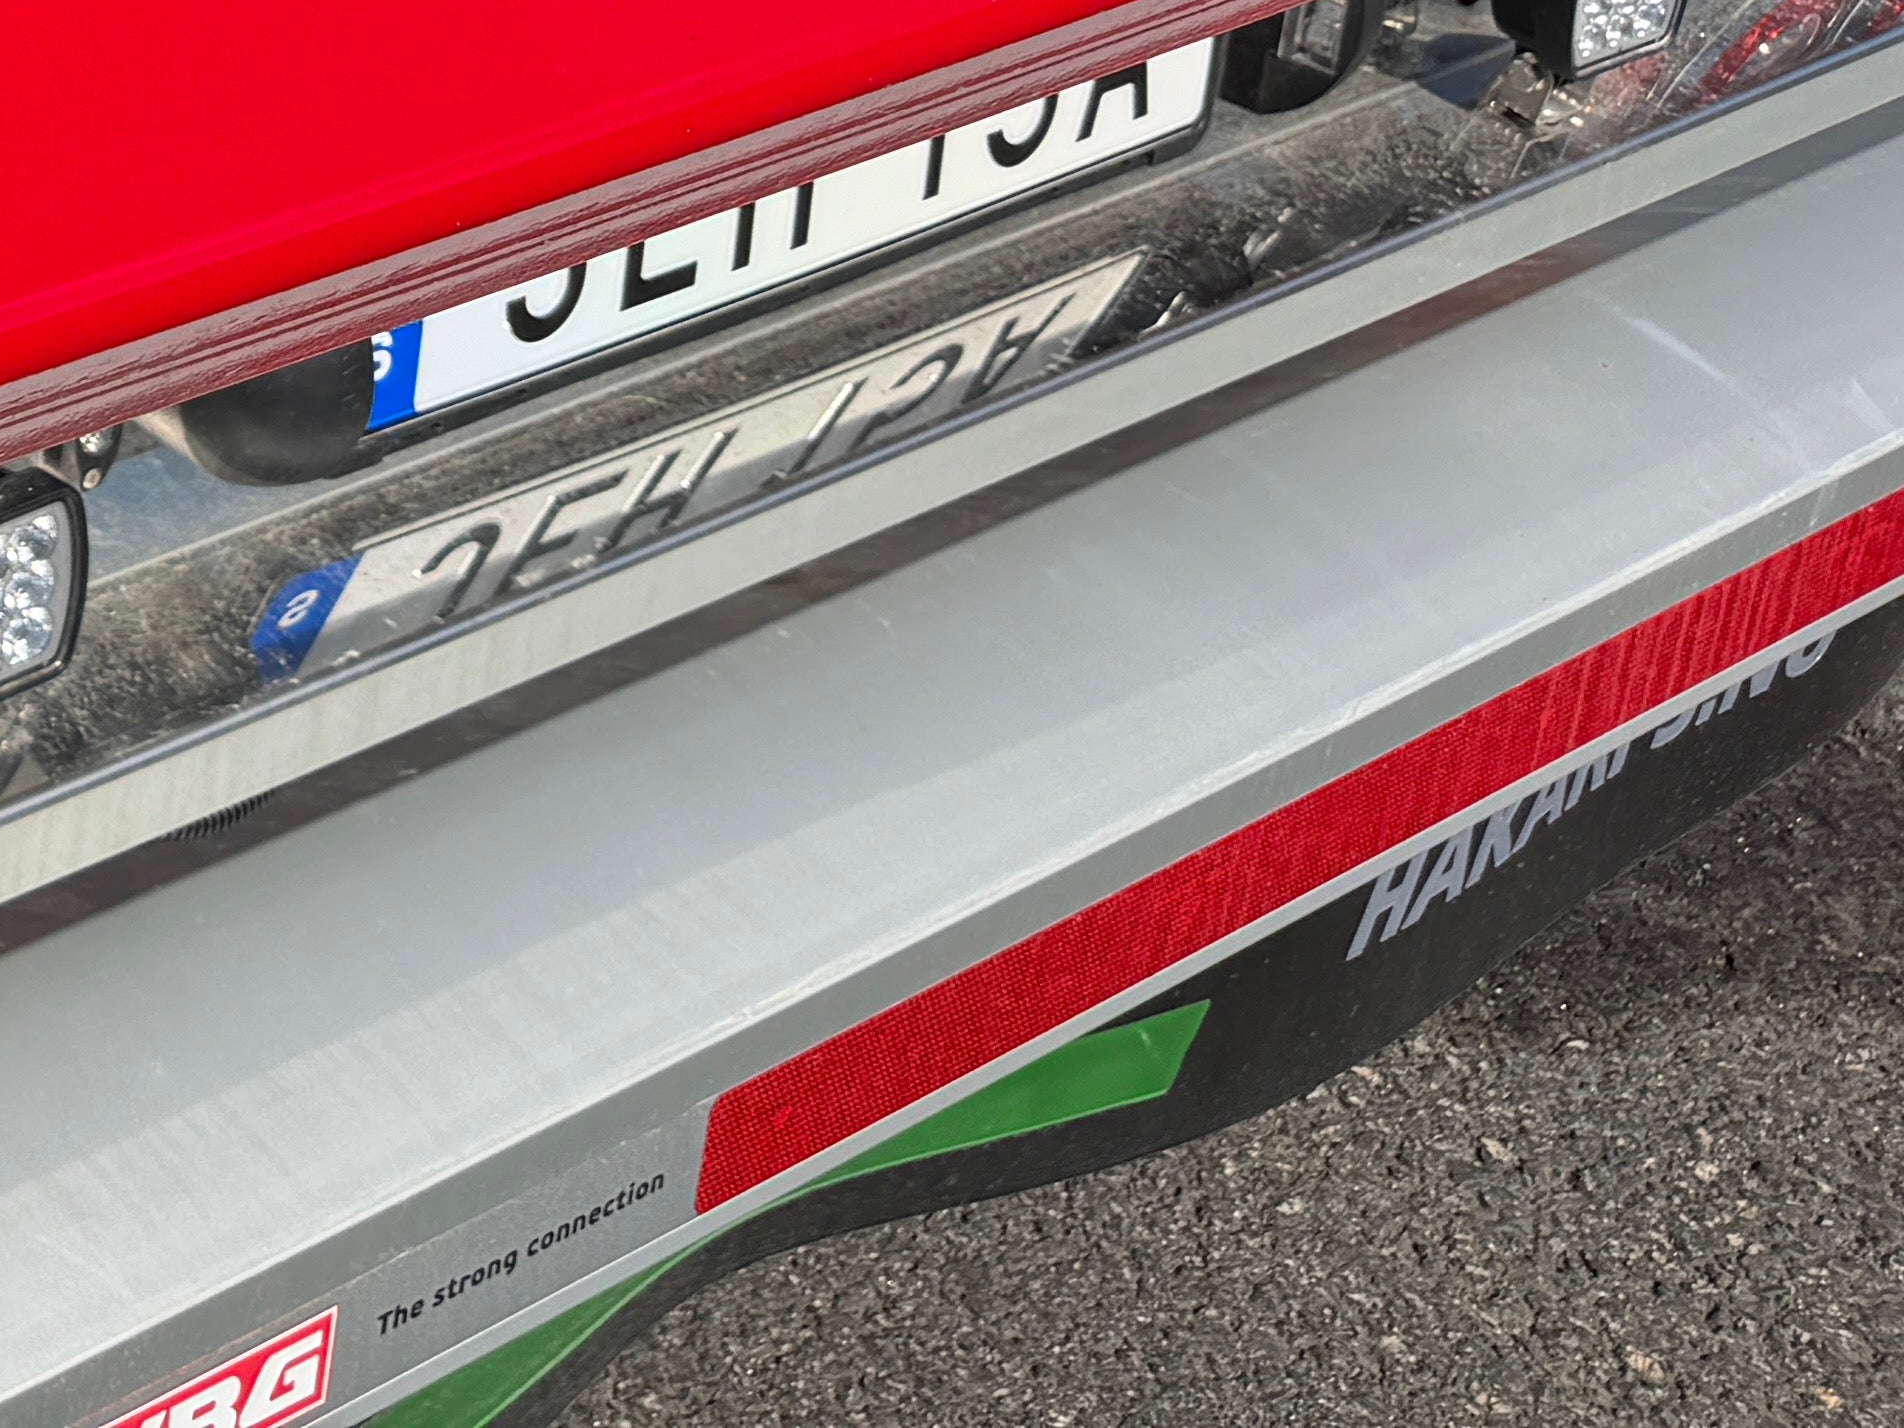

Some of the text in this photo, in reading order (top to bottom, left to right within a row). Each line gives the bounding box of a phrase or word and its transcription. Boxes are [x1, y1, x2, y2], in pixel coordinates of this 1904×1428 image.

[377, 1173, 665, 1335] The strong connection
[139, 1328, 324, 1428] BG
